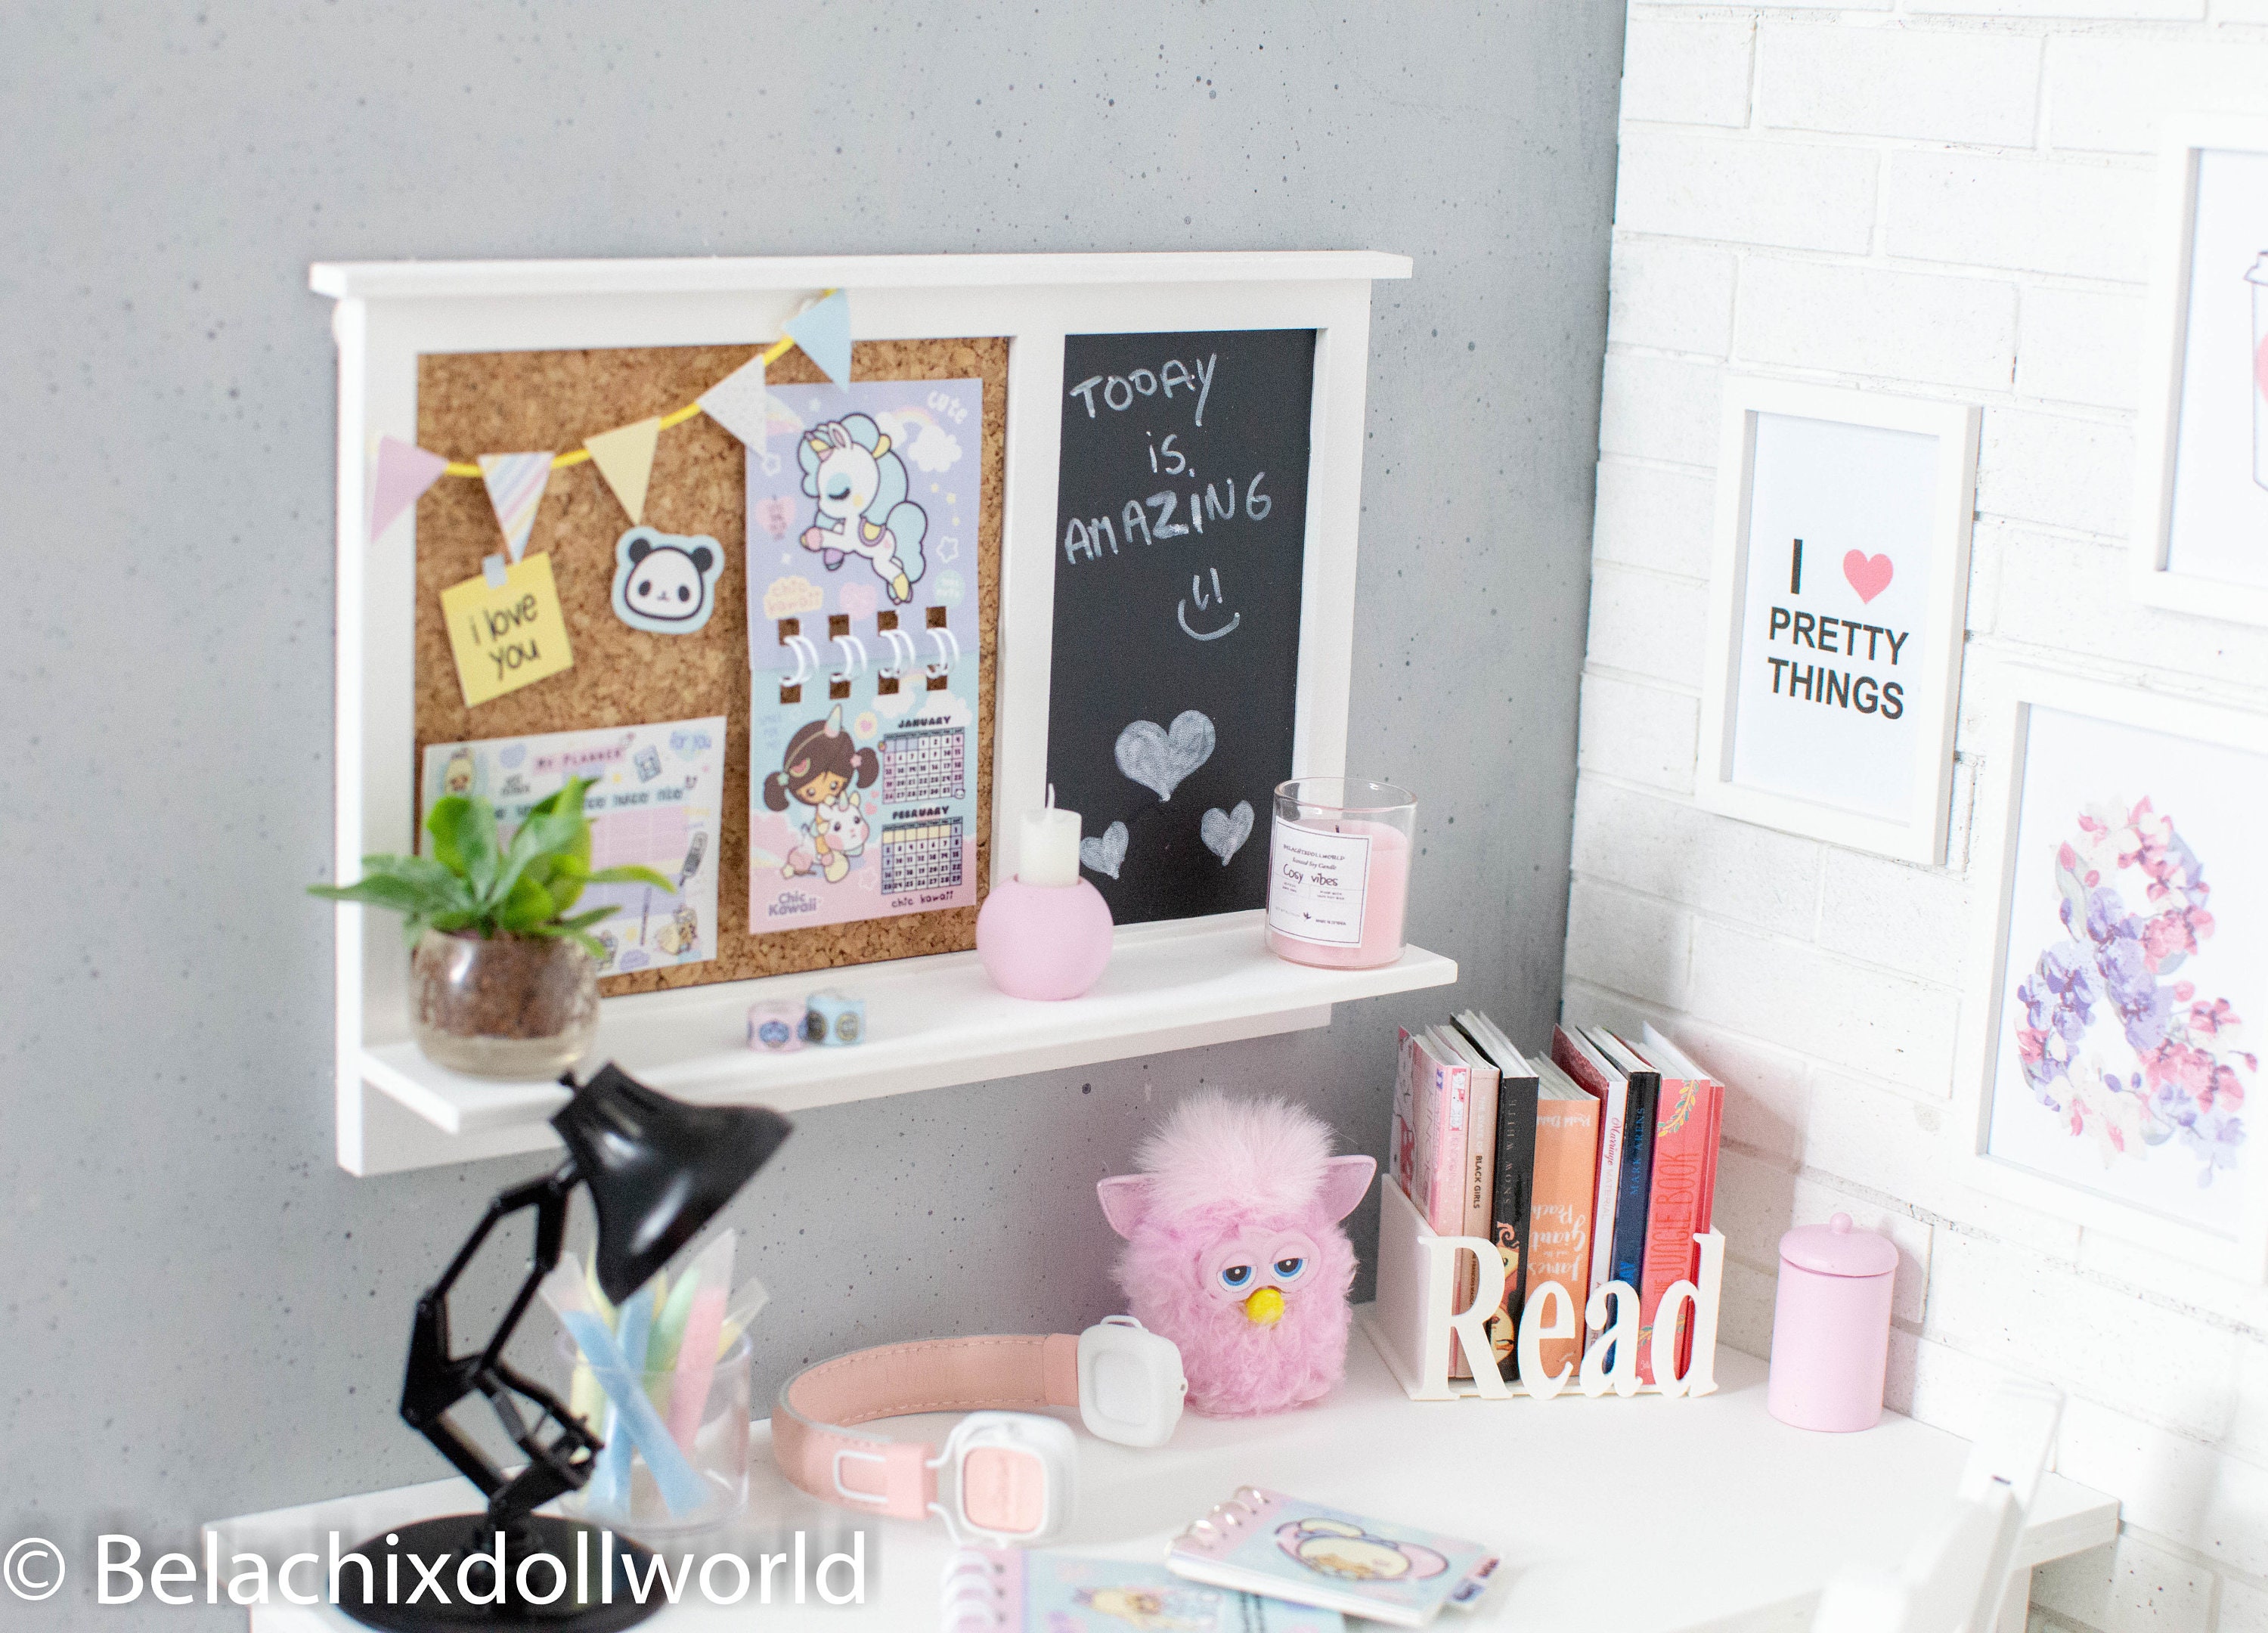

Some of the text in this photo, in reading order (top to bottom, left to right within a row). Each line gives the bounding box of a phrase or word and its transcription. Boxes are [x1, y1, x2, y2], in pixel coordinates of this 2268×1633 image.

[1070, 352, 1217, 427] TODAY
[1064, 471, 1272, 565] AMAZING
[1790, 538, 1803, 594] I
[483, 593, 538, 641] love
[1769, 606, 1910, 666] PRETTY
[488, 640, 541, 681] you
[1768, 656, 1904, 720] THINGS
[898, 715, 951, 728] JANUARY
[892, 805, 950, 820] FEBRUARY
[1311, 873, 1339, 886] vibes
[1504, 1160, 1513, 1204] SNOW
[1601, 1117, 1622, 1219] Marriage MATERIAL
[1630, 1159, 1641, 1195] MARK
[1656, 1152, 1699, 1204] BOOK
[1473, 1185, 1481, 1209] GIRLS
[1531, 1204, 1573, 1224] Peach
[1532, 1215, 1586, 1252] Giant
[1649, 1213, 1692, 1276] JUNGLE
[1526, 1253, 1582, 1281] James
[1411, 1233, 1724, 1401] Read
